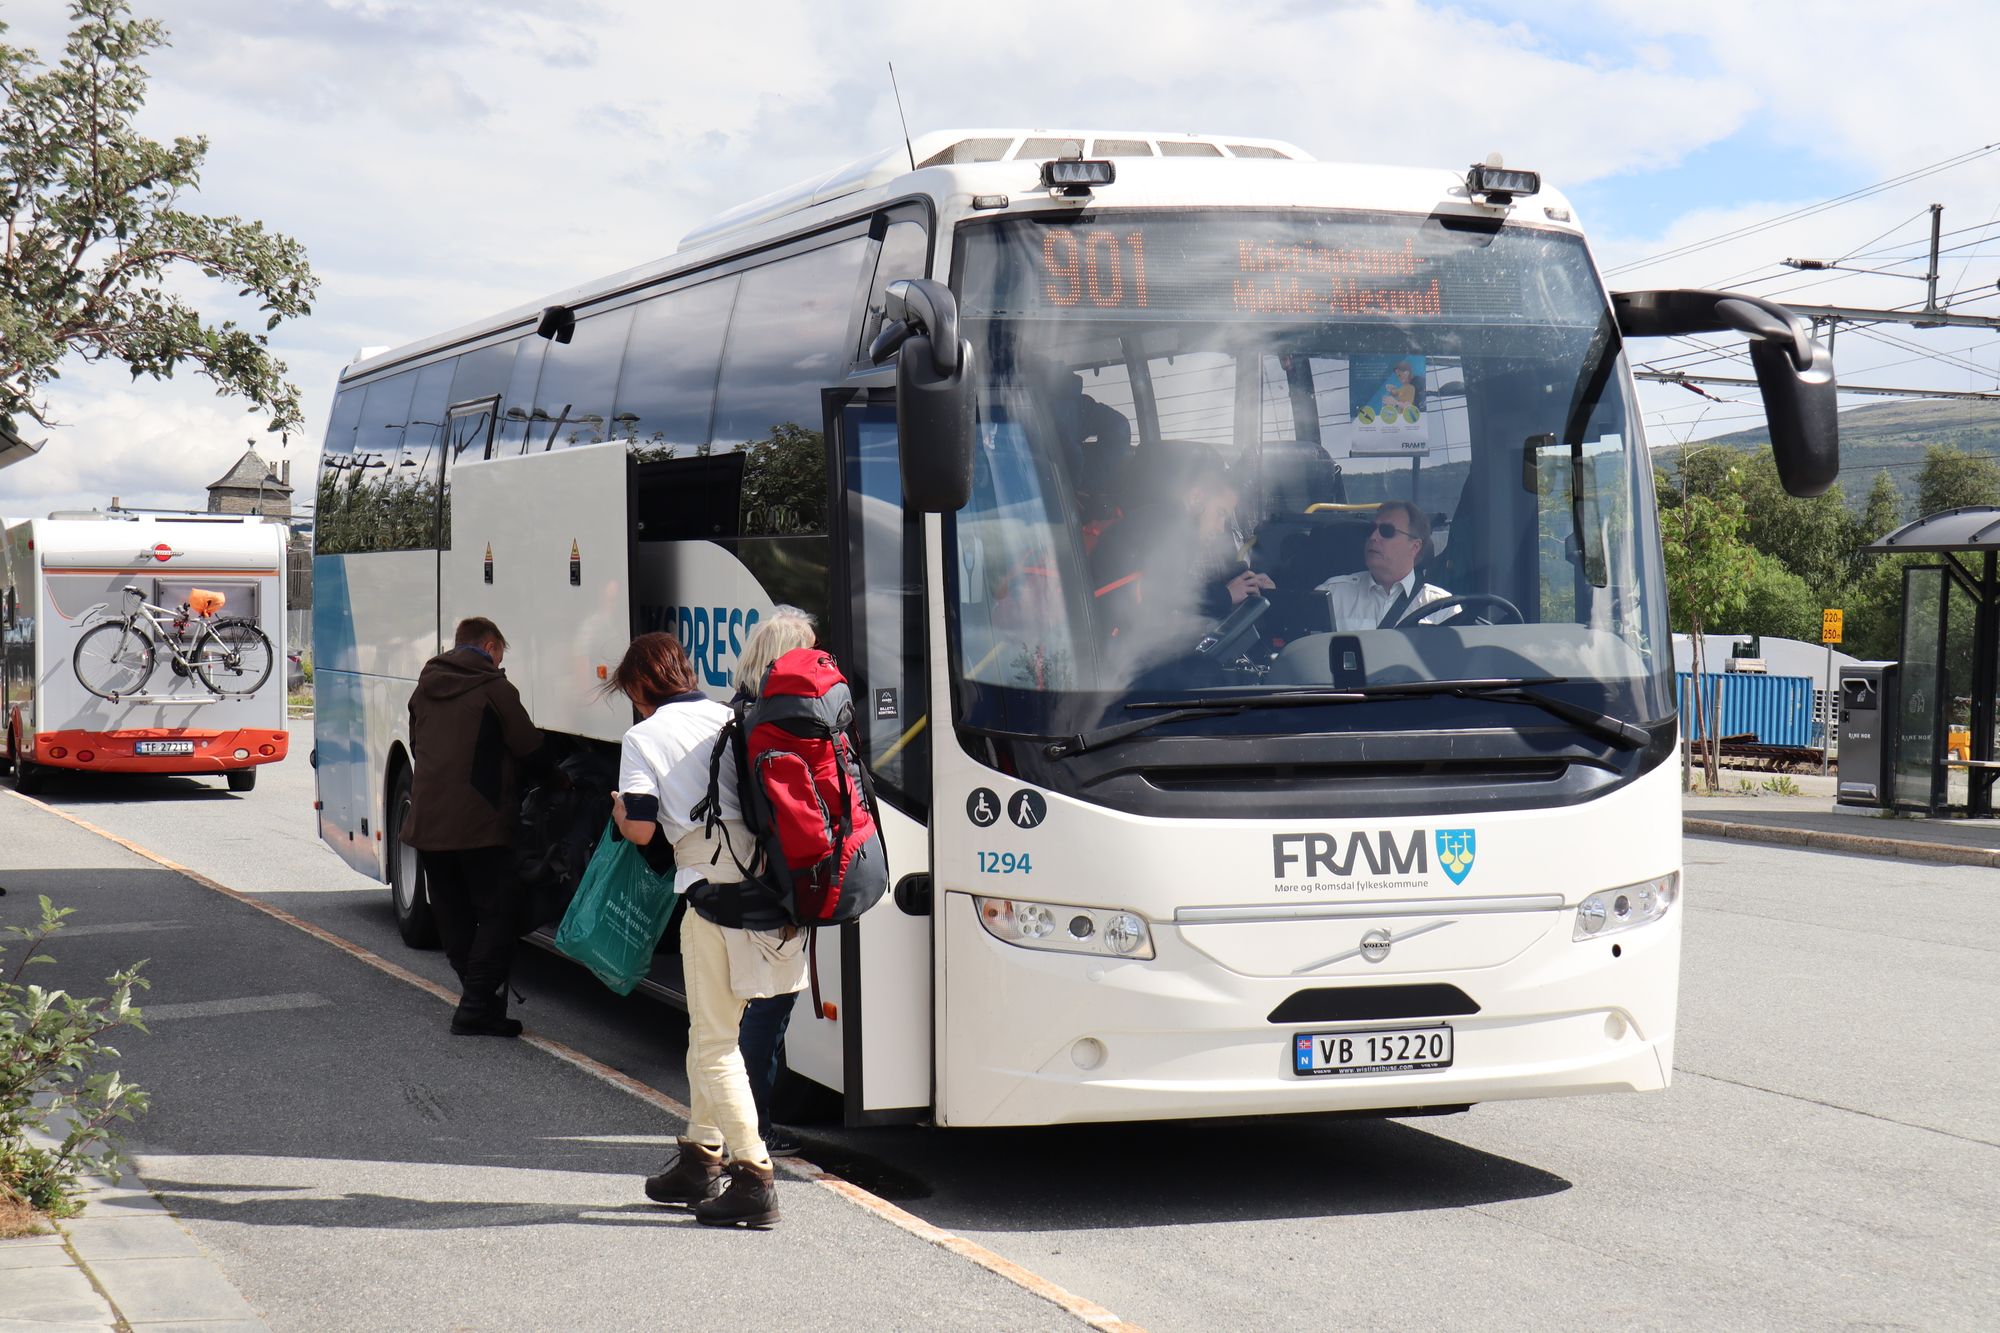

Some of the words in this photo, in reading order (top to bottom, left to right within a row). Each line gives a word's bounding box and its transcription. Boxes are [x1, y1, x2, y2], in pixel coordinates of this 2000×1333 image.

[1043, 230, 1148, 307] 901
[145, 743, 156, 751] TF
[161, 743, 189, 751] 27213
[977, 851, 1033, 874] 1294
[1272, 829, 1428, 879] FRAM
[1274, 883, 1299, 892] Møre
[1300, 884, 1313, 894] og
[1314, 881, 1355, 891] Romsdal
[1356, 879, 1429, 891] fylkeskommune
[1320, 1038, 1354, 1064] VB
[1367, 1033, 1444, 1062] 15220
[1301, 1056, 1309, 1065] N
